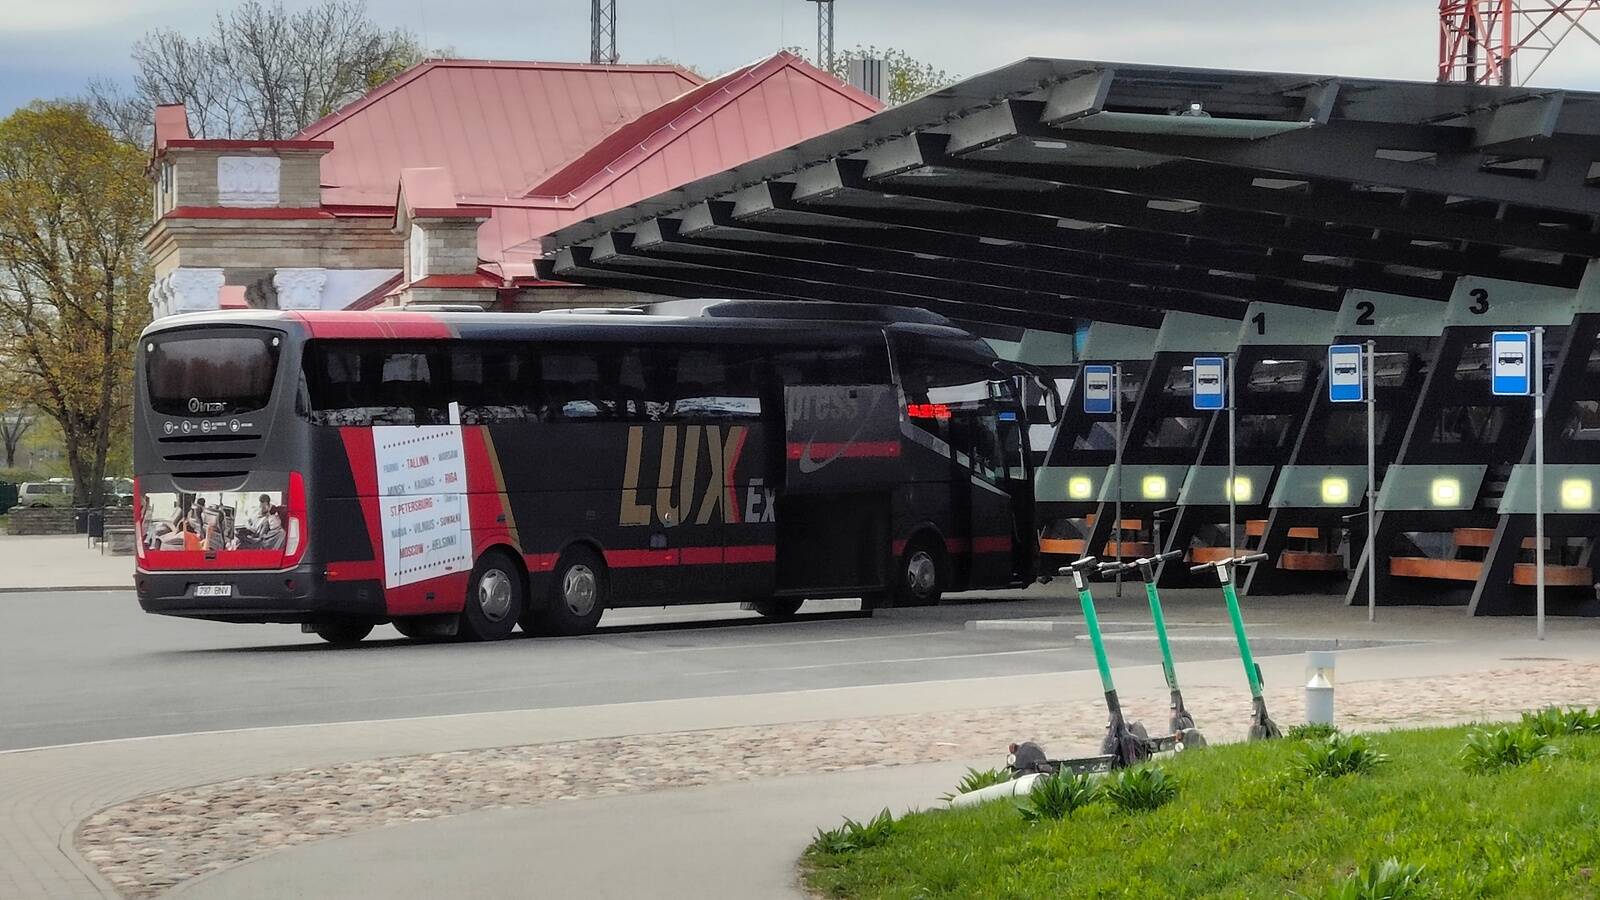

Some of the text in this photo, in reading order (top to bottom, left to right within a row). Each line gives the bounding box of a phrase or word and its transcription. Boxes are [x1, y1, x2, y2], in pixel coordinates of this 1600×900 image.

[1468, 288, 1490, 315] 3
[1252, 313, 1265, 334] 1
[1355, 301, 1376, 326] 2
[407, 455, 429, 468] TALLINN
[445, 472, 458, 484] RIGA
[619, 425, 748, 527] LUX
[400, 544, 423, 558] MOSCOW
